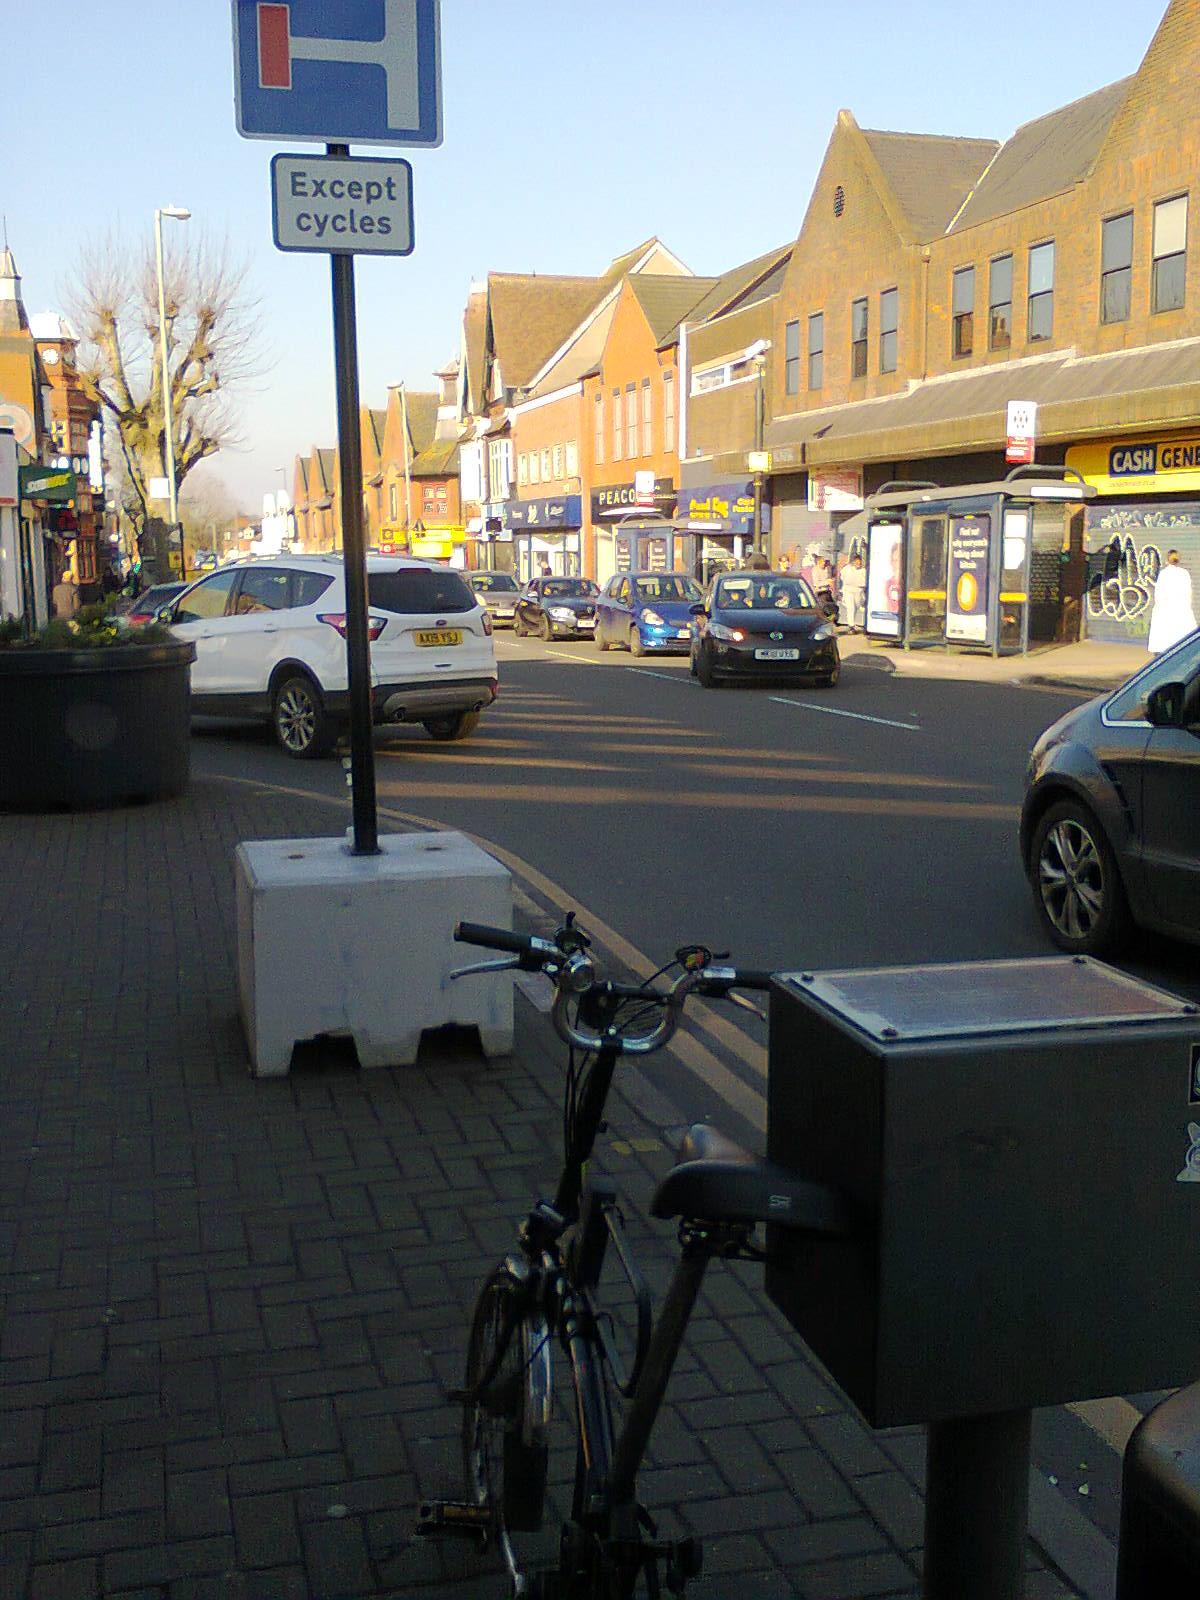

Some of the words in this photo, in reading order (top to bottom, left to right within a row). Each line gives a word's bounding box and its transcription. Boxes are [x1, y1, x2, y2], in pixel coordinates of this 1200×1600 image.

[290, 171, 397, 204] Except
[296, 208, 392, 237] cycles
[1112, 448, 1155, 473] CASH
[598, 486, 638, 506] PEACO
